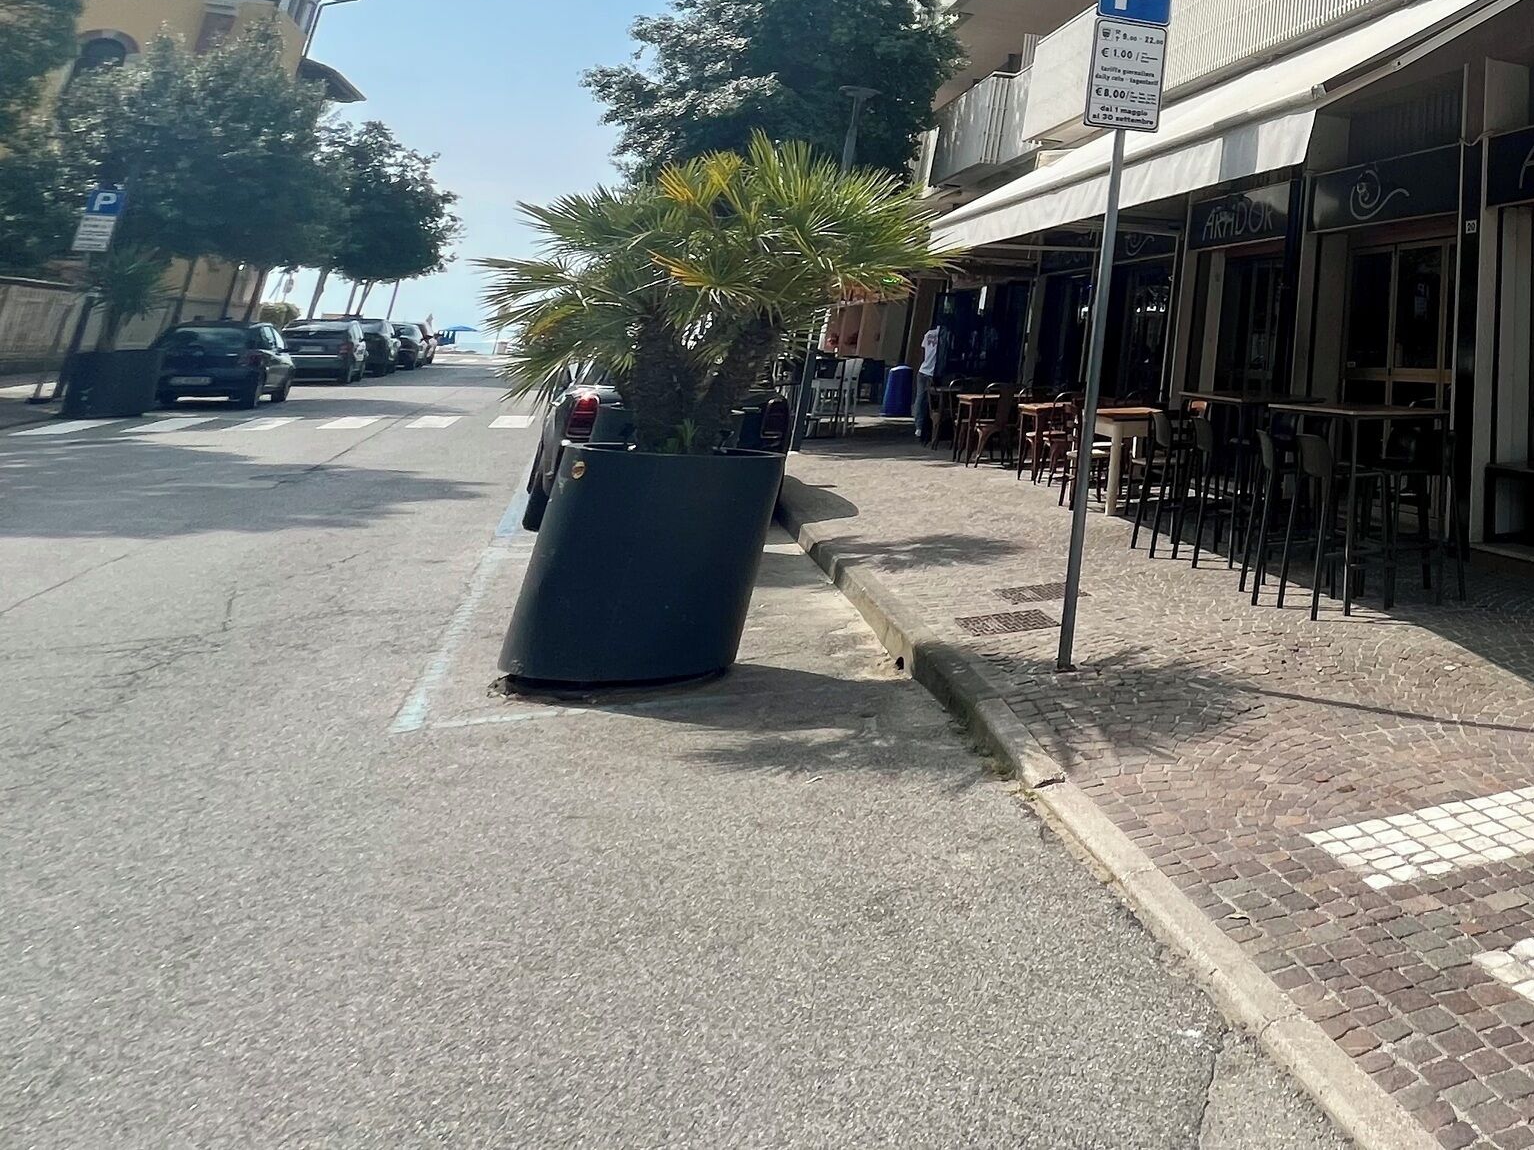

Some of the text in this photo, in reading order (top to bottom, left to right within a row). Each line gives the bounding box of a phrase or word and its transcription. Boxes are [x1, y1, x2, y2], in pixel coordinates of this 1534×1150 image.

[1144, 35, 1164, 45] 22.00
[1100, 104, 1113, 113] dal
[1120, 108, 1148, 118] maggio
[1101, 113, 1114, 121] 30
[1114, 116, 1154, 126] settembre
[93, 192, 118, 211] P
